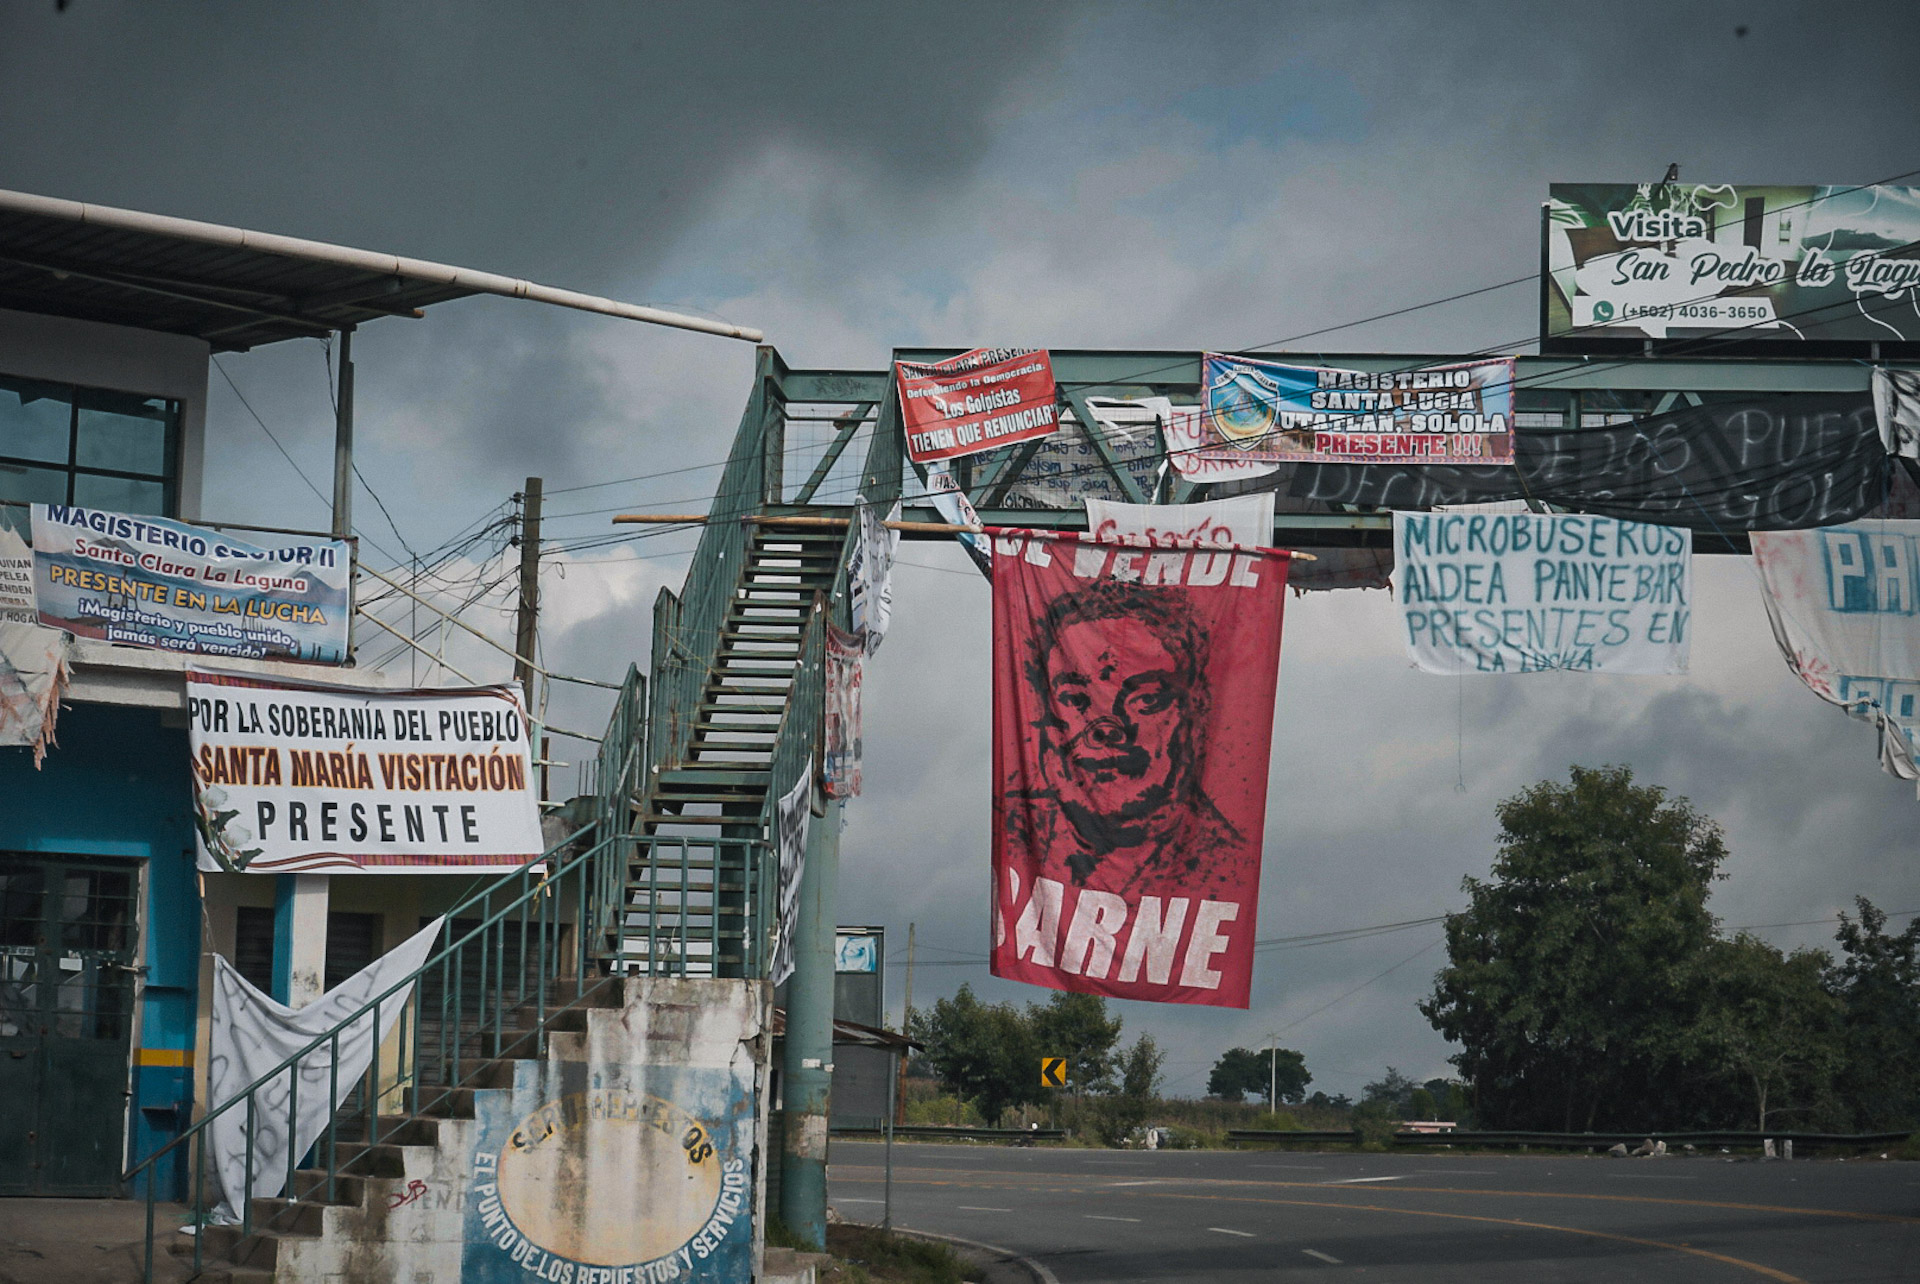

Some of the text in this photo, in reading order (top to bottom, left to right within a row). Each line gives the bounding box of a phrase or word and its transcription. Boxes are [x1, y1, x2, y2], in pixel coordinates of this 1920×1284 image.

[1612, 212, 1704, 238] Visita
[1611, 252, 1920, 292] San Pedro la Lagu
[1623, 301, 1768, 322] (+502) 4036-3650
[907, 362, 1046, 399] Defendiendo la Democracia.
[1316, 370, 1471, 391] MAGISTERIO
[965, 388, 1021, 416] Golpistas
[1310, 391, 1476, 411] SANTA LUCIA
[911, 428, 955, 453] TIENEN
[956, 424, 982, 448] QUE
[1279, 410, 1507, 434] UTATLAN, SOLOLA
[1315, 432, 1483, 457] PRESENTE !!!
[47, 503, 206, 558] MAGISTERIO
[1404, 514, 1685, 558] MICROBUSEROS
[75, 538, 307, 592] Santa Clara La Laguna
[1403, 559, 1687, 605] ALDEA PANYEBAR
[50, 564, 328, 626] PRESENTE EN LA LUCHA
[107, 624, 267, 660] jamás será vencido!
[174, 621, 184, 633] y
[189, 620, 243, 640] pueblo
[247, 628, 296, 648] unido,
[1405, 606, 1690, 650] PRESENTES EN
[1476, 650, 1506, 673] LA
[188, 696, 519, 743] POR LA SOBERANÍA DEL PUEBLO
[200, 741, 526, 792] SANTA MARÍA VISITACIÓN
[257, 801, 480, 843] PRESENTE
[998, 867, 1241, 990] ARNE
[473, 1151, 498, 1179] EL
[474, 1183, 519, 1251] PUNTO
[692, 1158, 745, 1260] SERVICIOS
[510, 1238, 541, 1271] DE
[536, 1252, 575, 1283] LOS
[575, 1255, 681, 1284] REPUESTOS
[678, 1247, 695, 1270] Y
